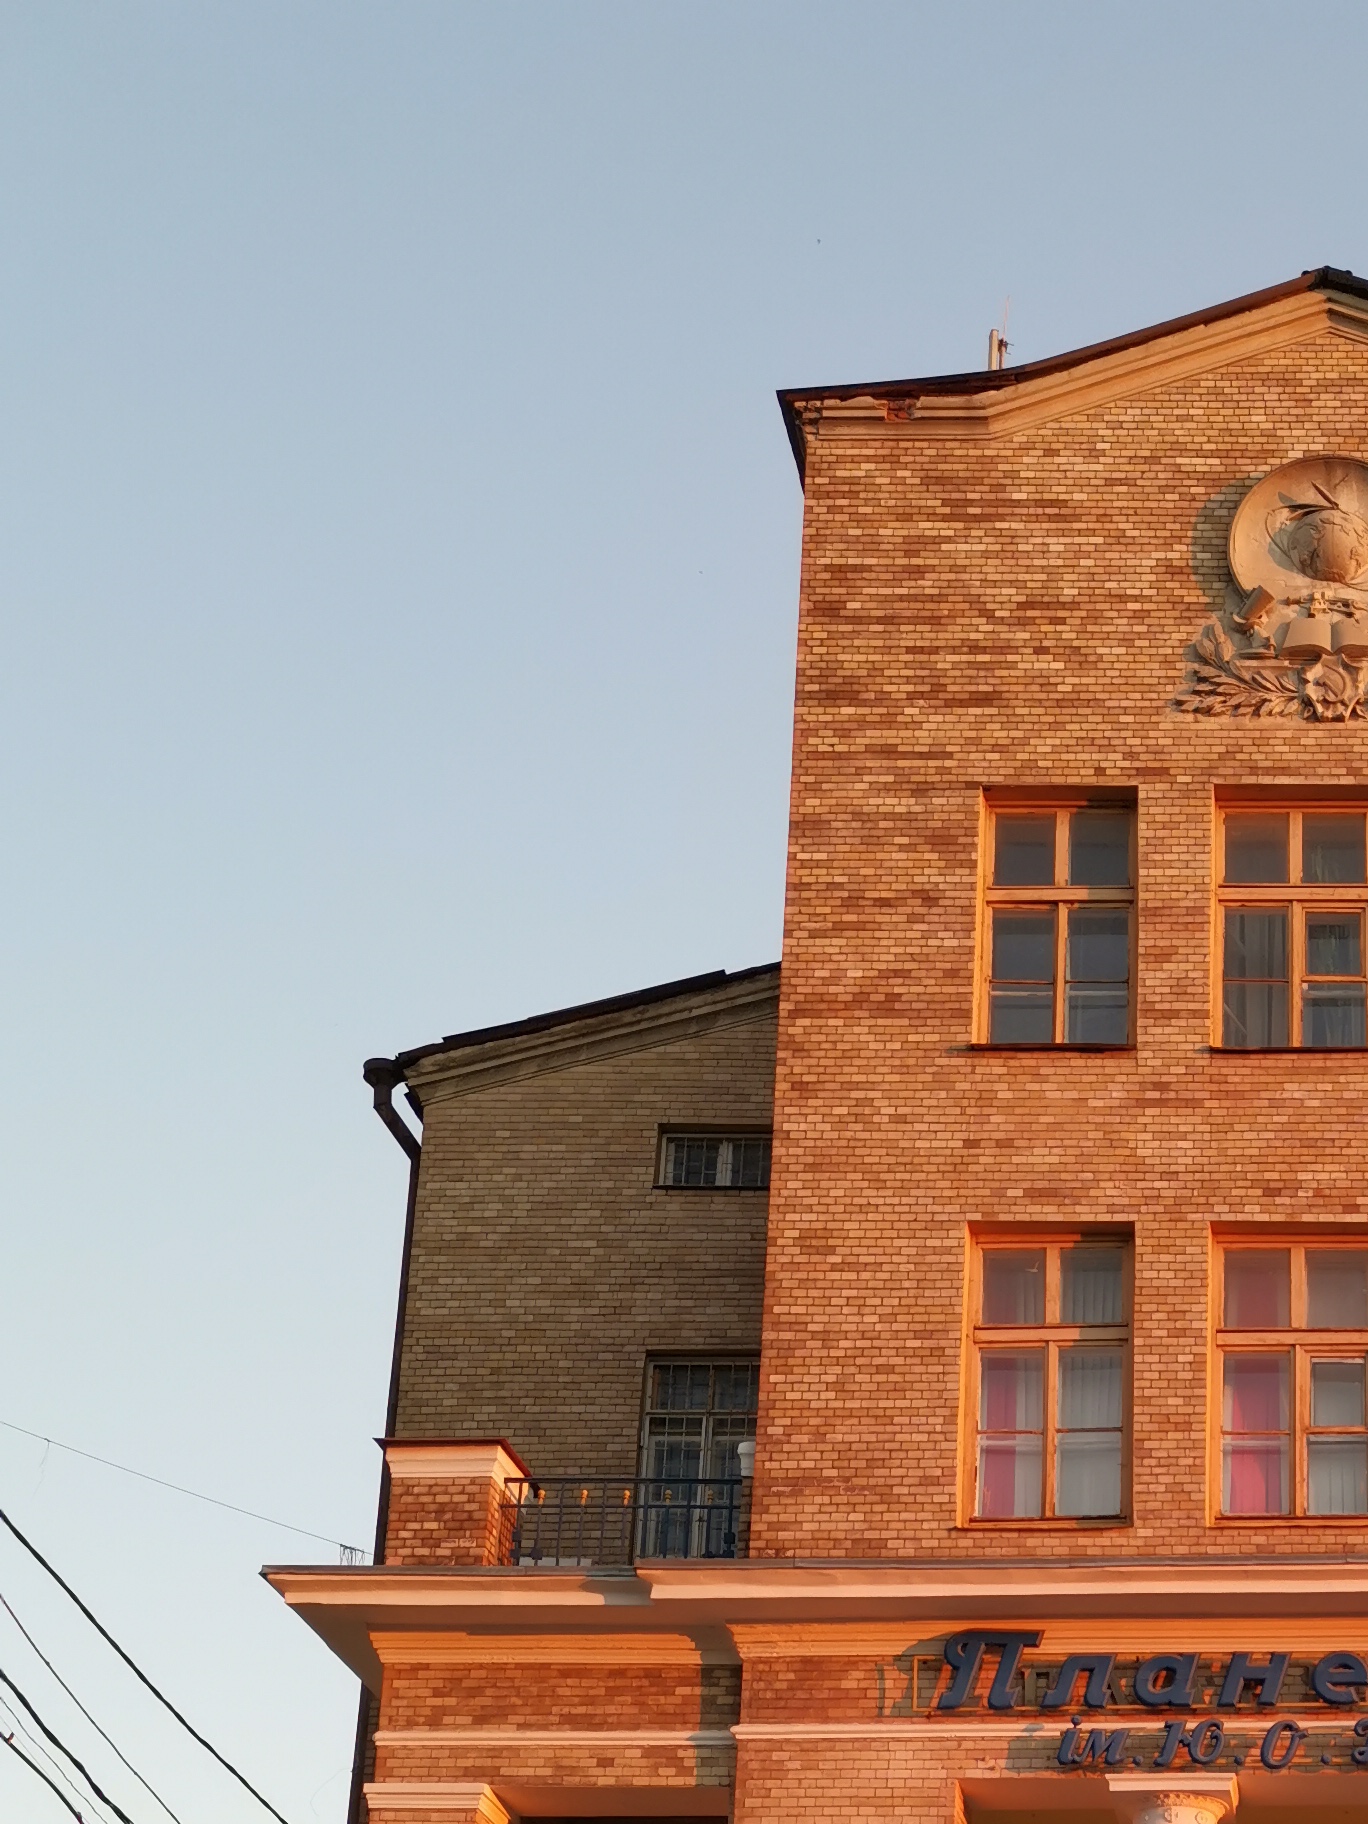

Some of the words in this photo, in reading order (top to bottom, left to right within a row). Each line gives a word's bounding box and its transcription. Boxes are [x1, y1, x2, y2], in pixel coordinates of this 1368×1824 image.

[1057, 1715, 1144, 1767] ім.
[1154, 1719, 1245, 1767] Ю.
[1260, 1719, 1332, 1770] О.
